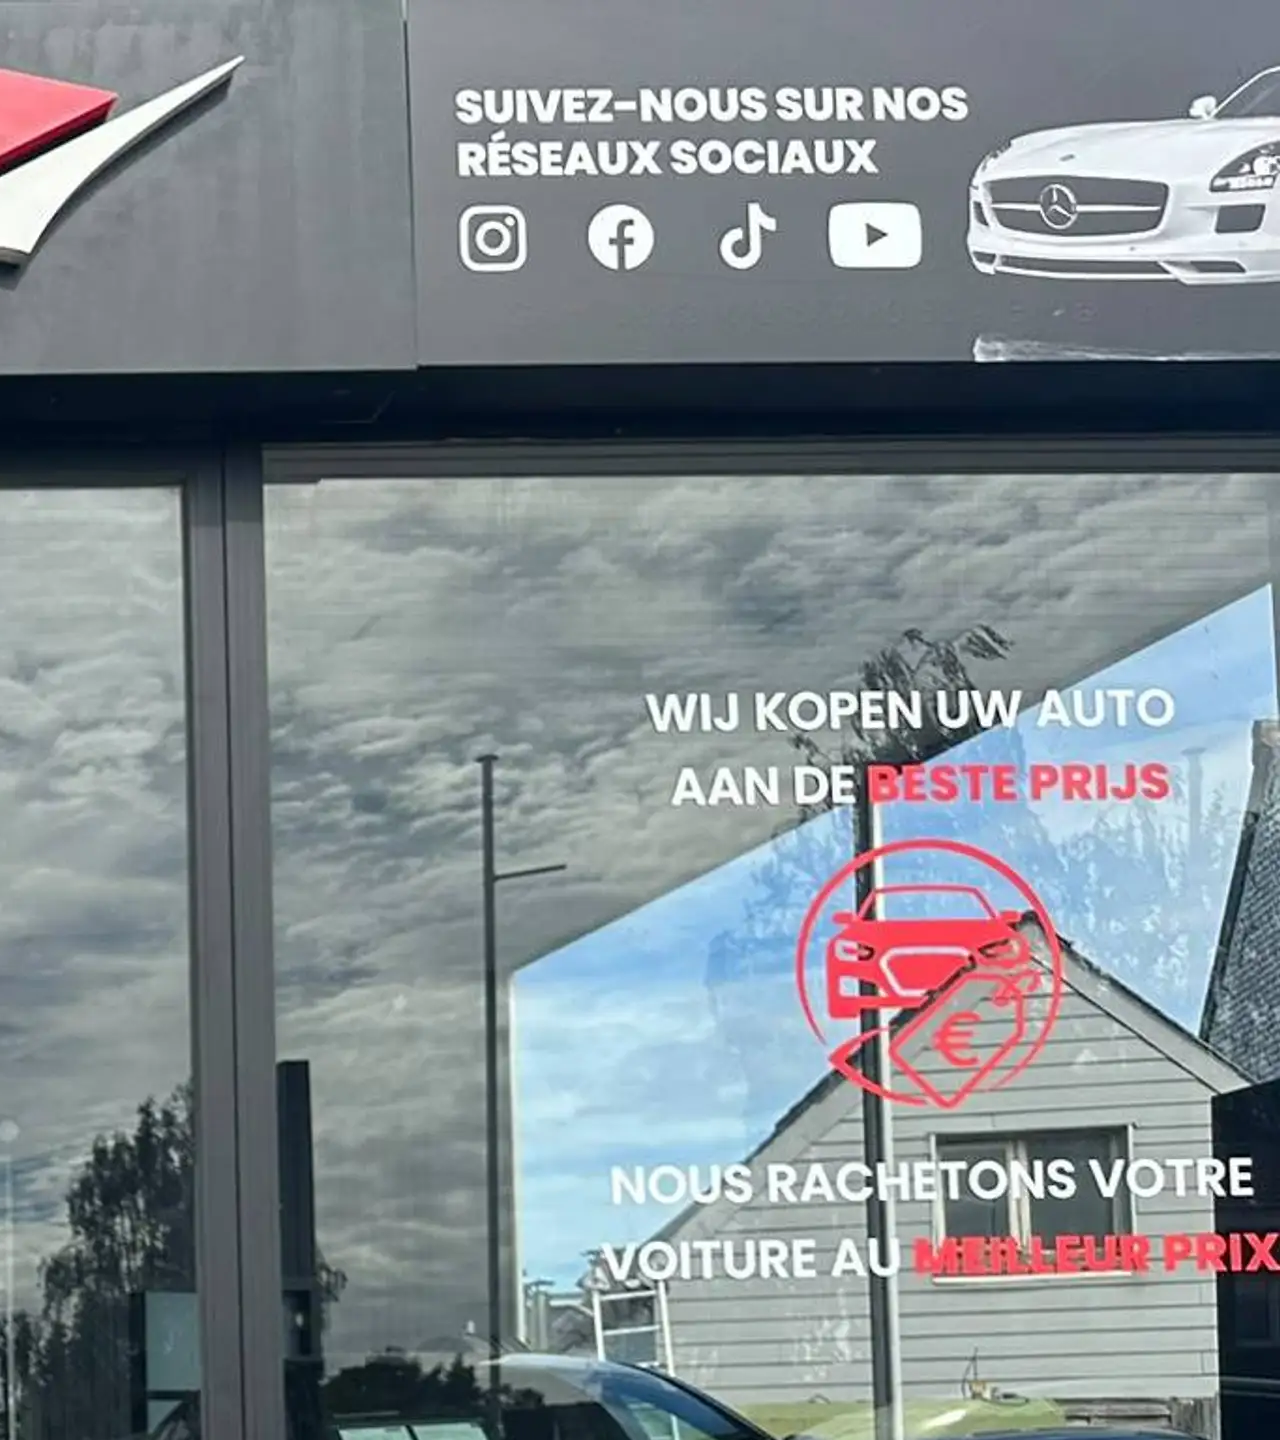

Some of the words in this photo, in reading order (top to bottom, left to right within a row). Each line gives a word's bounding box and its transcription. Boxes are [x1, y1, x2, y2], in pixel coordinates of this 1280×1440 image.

[455, 87, 769, 125] SUIVEZ-NOUS
[774, 87, 865, 122] SUR
[872, 86, 969, 122] NOS
[457, 129, 663, 177] RÉSEAUX
[669, 138, 879, 175] SOCIAUX
[645, 692, 740, 733] WIJ
[754, 689, 923, 732] KOPEN
[936, 689, 1023, 729] UW
[1036, 687, 1175, 728] AUTO
[670, 765, 781, 807] AAN
[793, 764, 857, 805] DE
[866, 762, 1018, 806] BESTE
[1029, 762, 1172, 802] PRIJS
[610, 1163, 754, 1209] NOUS
[765, 1159, 1077, 1204] RACHETONS
[1088, 1156, 1255, 1201] VOTRE
[602, 1238, 817, 1281] VOITURE
[831, 1236, 902, 1279] AU
[911, 1232, 1153, 1279] MEILLEUR
[1161, 1230, 1280, 1275] PRIX
